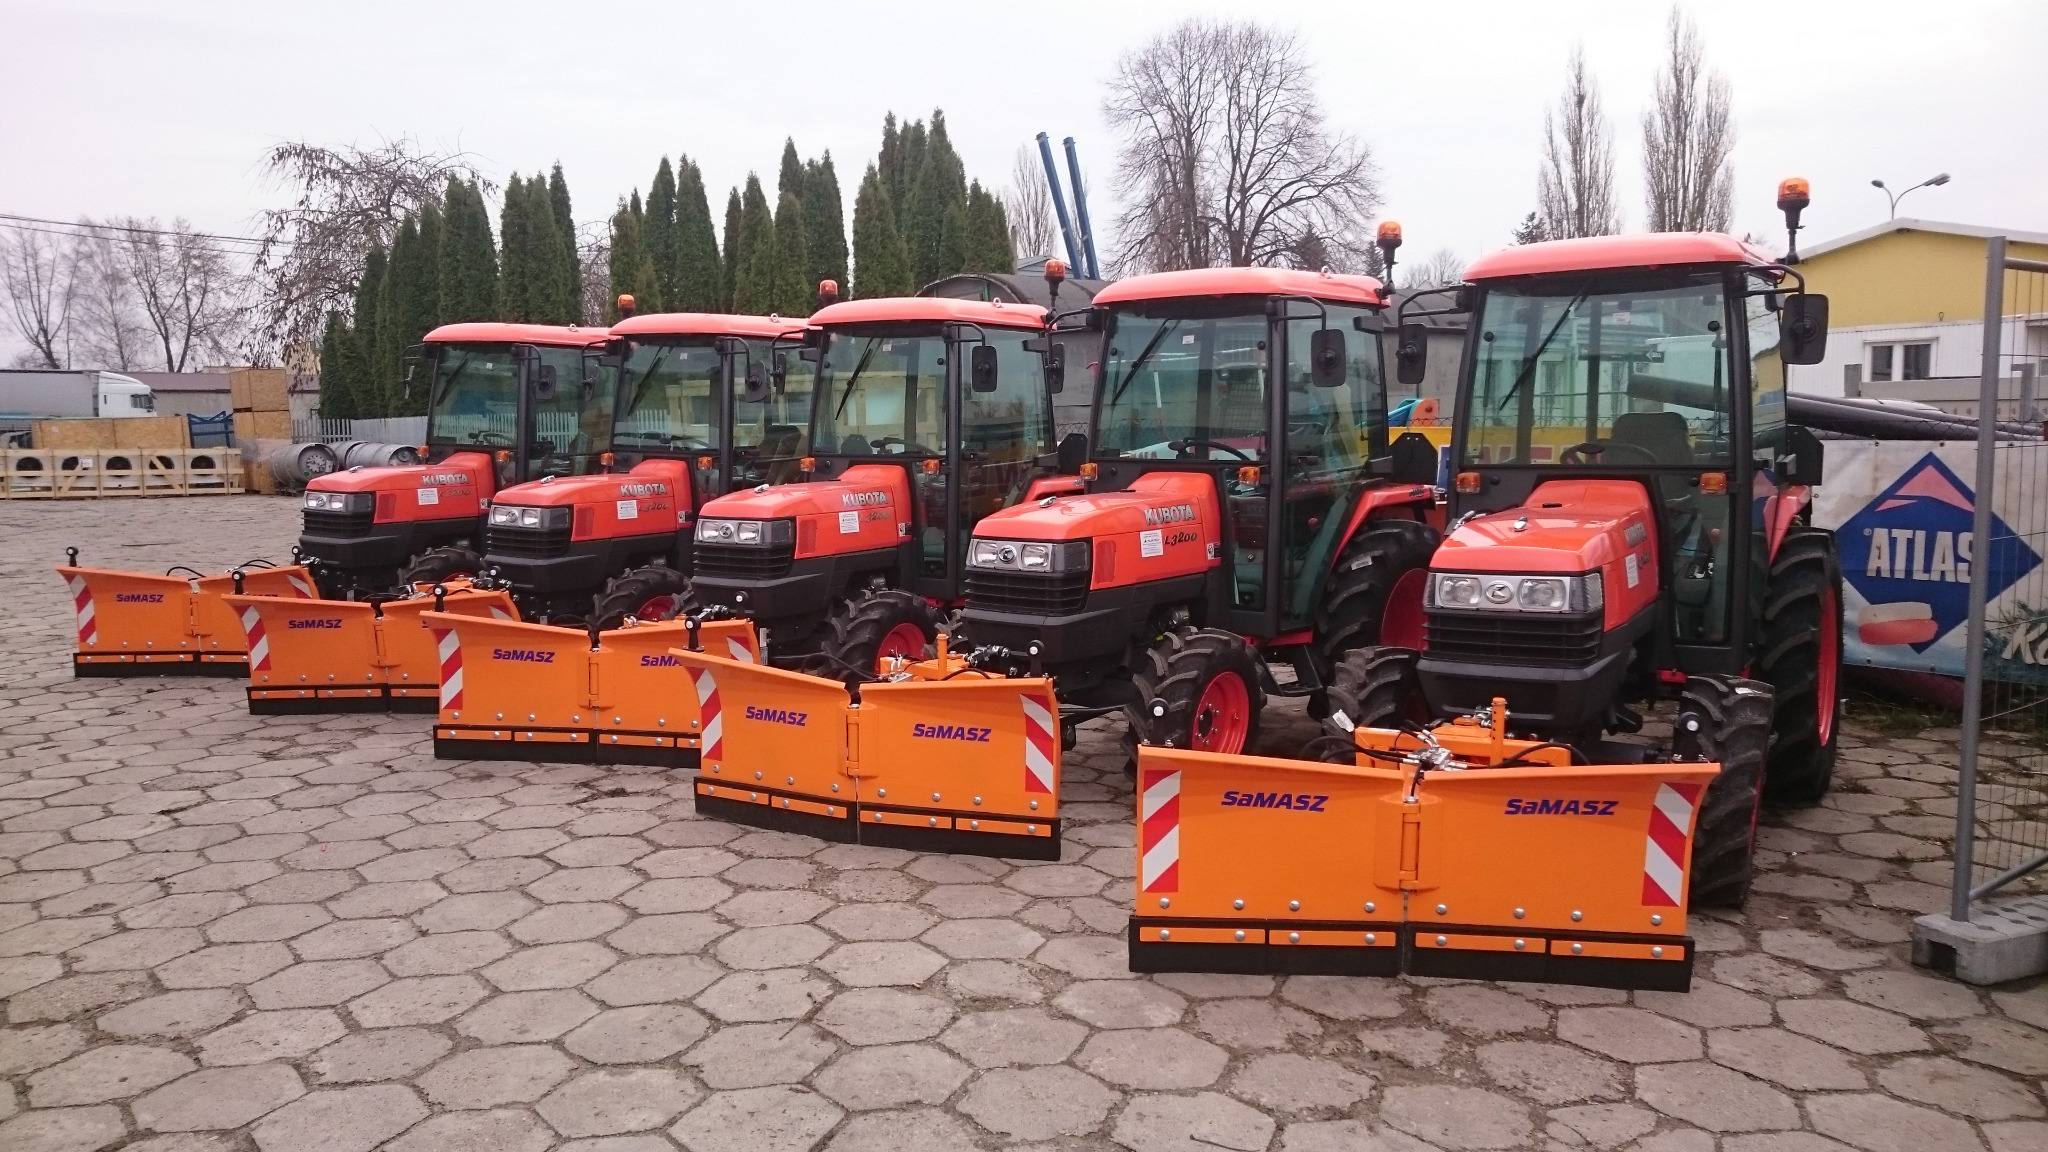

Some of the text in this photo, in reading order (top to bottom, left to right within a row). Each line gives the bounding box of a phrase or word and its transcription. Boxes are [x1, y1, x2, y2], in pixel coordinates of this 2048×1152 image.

[422, 474, 468, 485] KUBOTA
[620, 483, 667, 497] KUBOTA
[842, 491, 888, 507] KUBOTA
[1143, 504, 1195, 526] KUBOTA
[1163, 532, 1198, 546] L3200
[1866, 527, 1974, 584] ATLAS
[116, 593, 164, 603] SaMASZ
[288, 619, 342, 629] SaMASZ
[492, 648, 555, 663] SaMASZ
[745, 705, 808, 727] SaMASZ
[912, 723, 992, 743] SaMASZ
[1220, 790, 1330, 813] SaMASZ
[1504, 798, 1619, 816] SaMASZ
